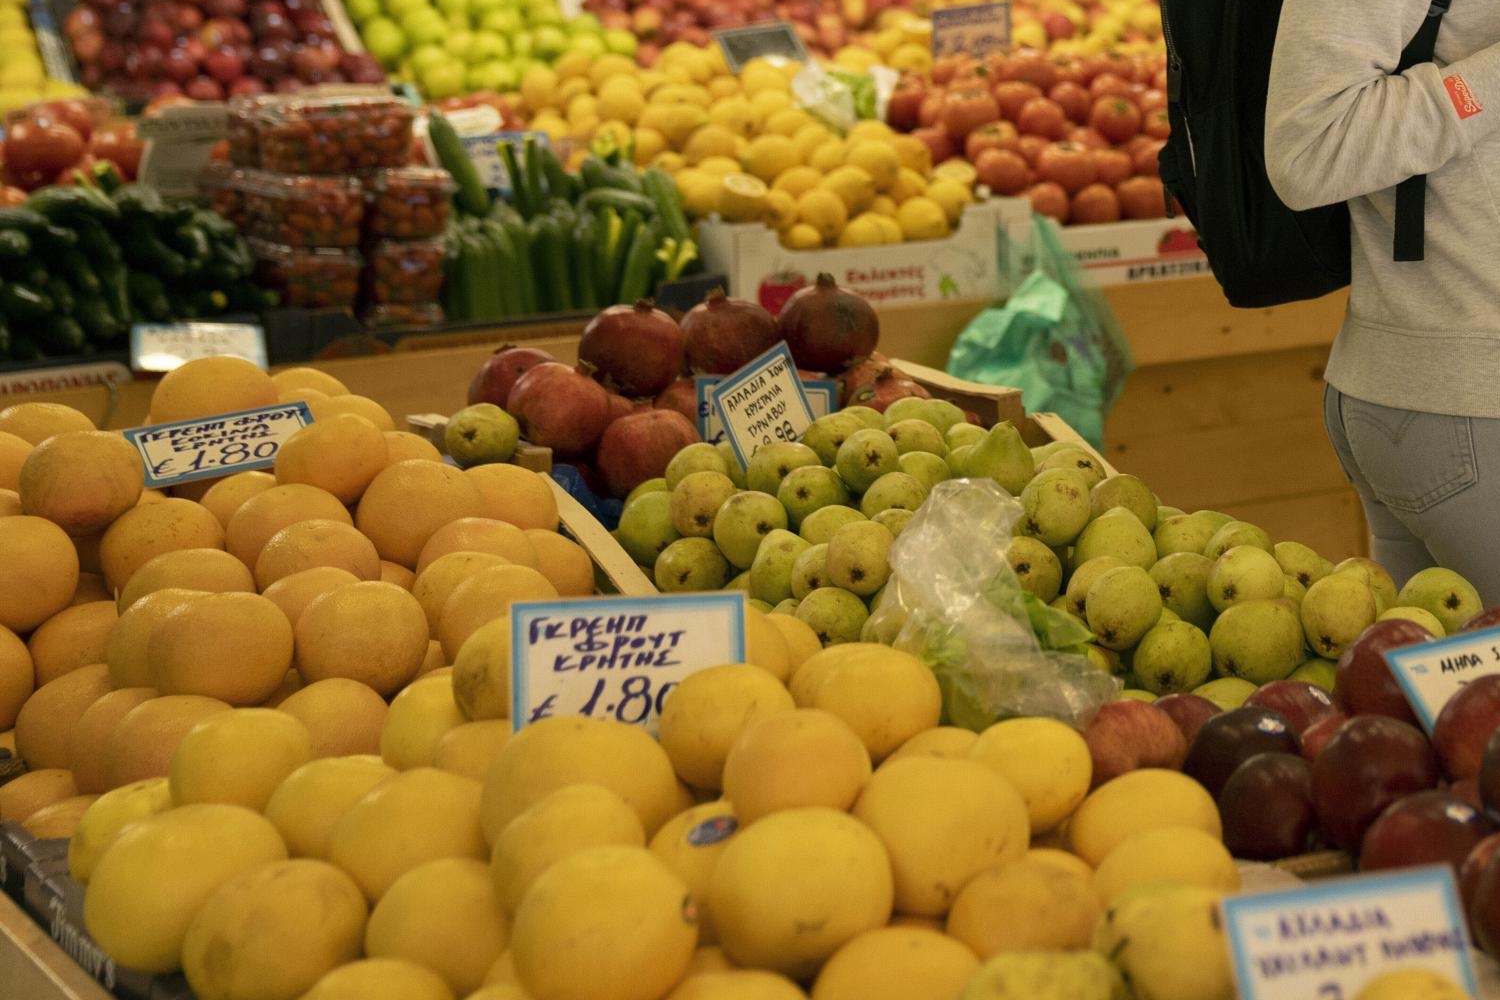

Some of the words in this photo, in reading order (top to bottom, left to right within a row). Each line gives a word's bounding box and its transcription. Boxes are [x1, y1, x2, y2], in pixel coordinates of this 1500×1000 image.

[233, 407, 308, 426] ΦΡΟΥΤ
[152, 458, 177, 476] €
[186, 441, 279, 473] 1.80
[529, 614, 648, 645] ΓΚΡΕΗΠ
[573, 629, 687, 653] ΦΡΟΥΤ
[553, 649, 681, 672] ΚΡΗΤΗΣ
[1440, 653, 1483, 674] ΜΗΛΑ
